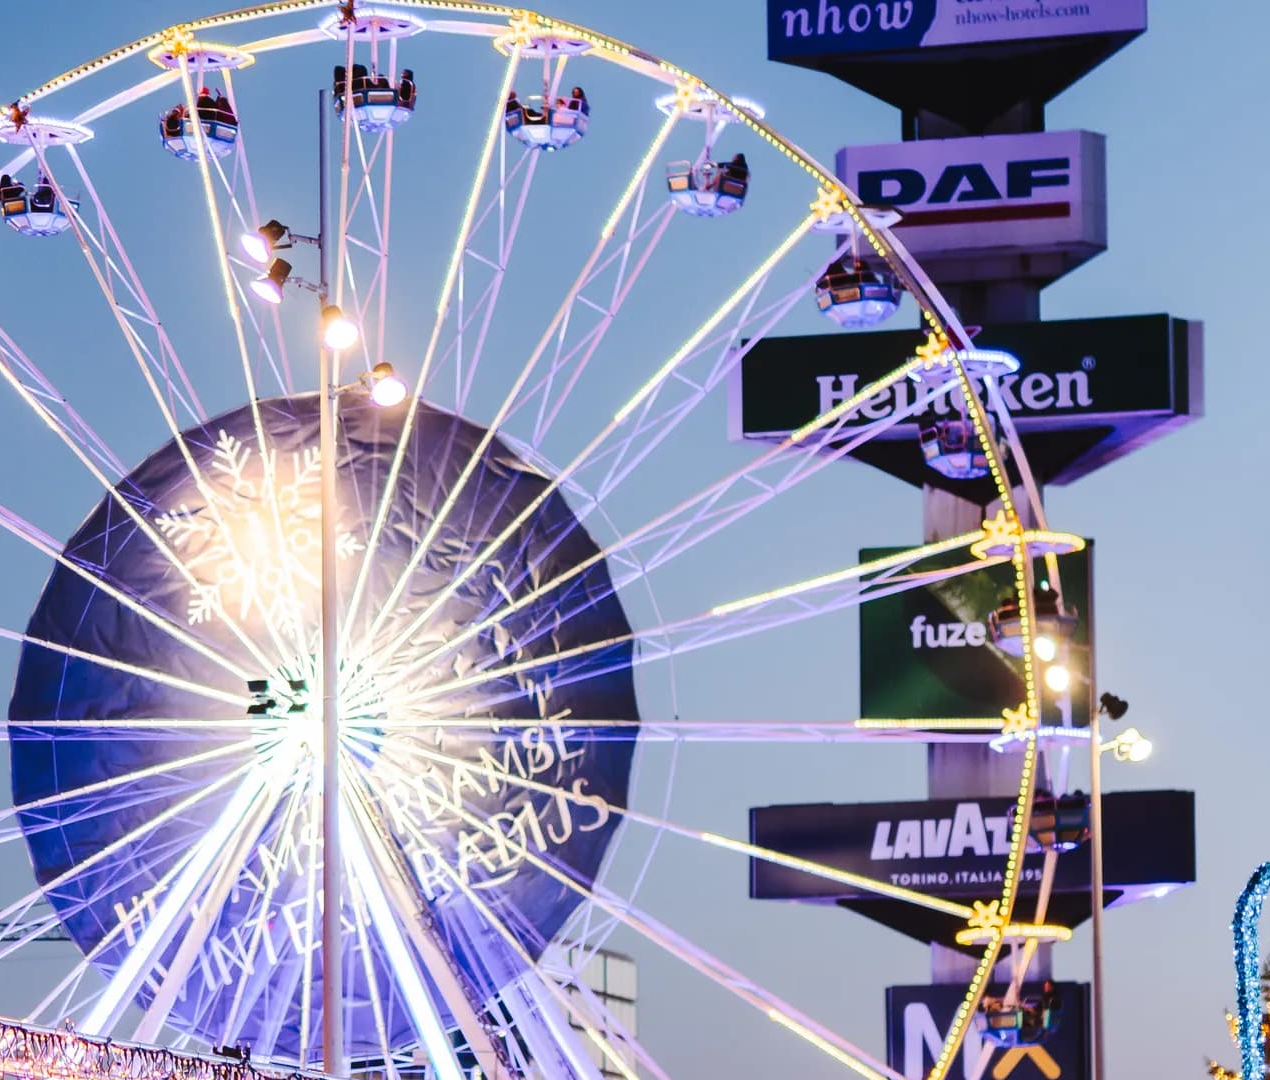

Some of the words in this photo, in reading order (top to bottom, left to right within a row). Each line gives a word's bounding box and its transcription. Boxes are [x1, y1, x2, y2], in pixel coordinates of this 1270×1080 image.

[782, 0, 913, 37] nhow
[955, 4, 1091, 26] nhow-hotels.com
[858, 158, 1070, 206] DAF
[910, 615, 987, 649] fuze
